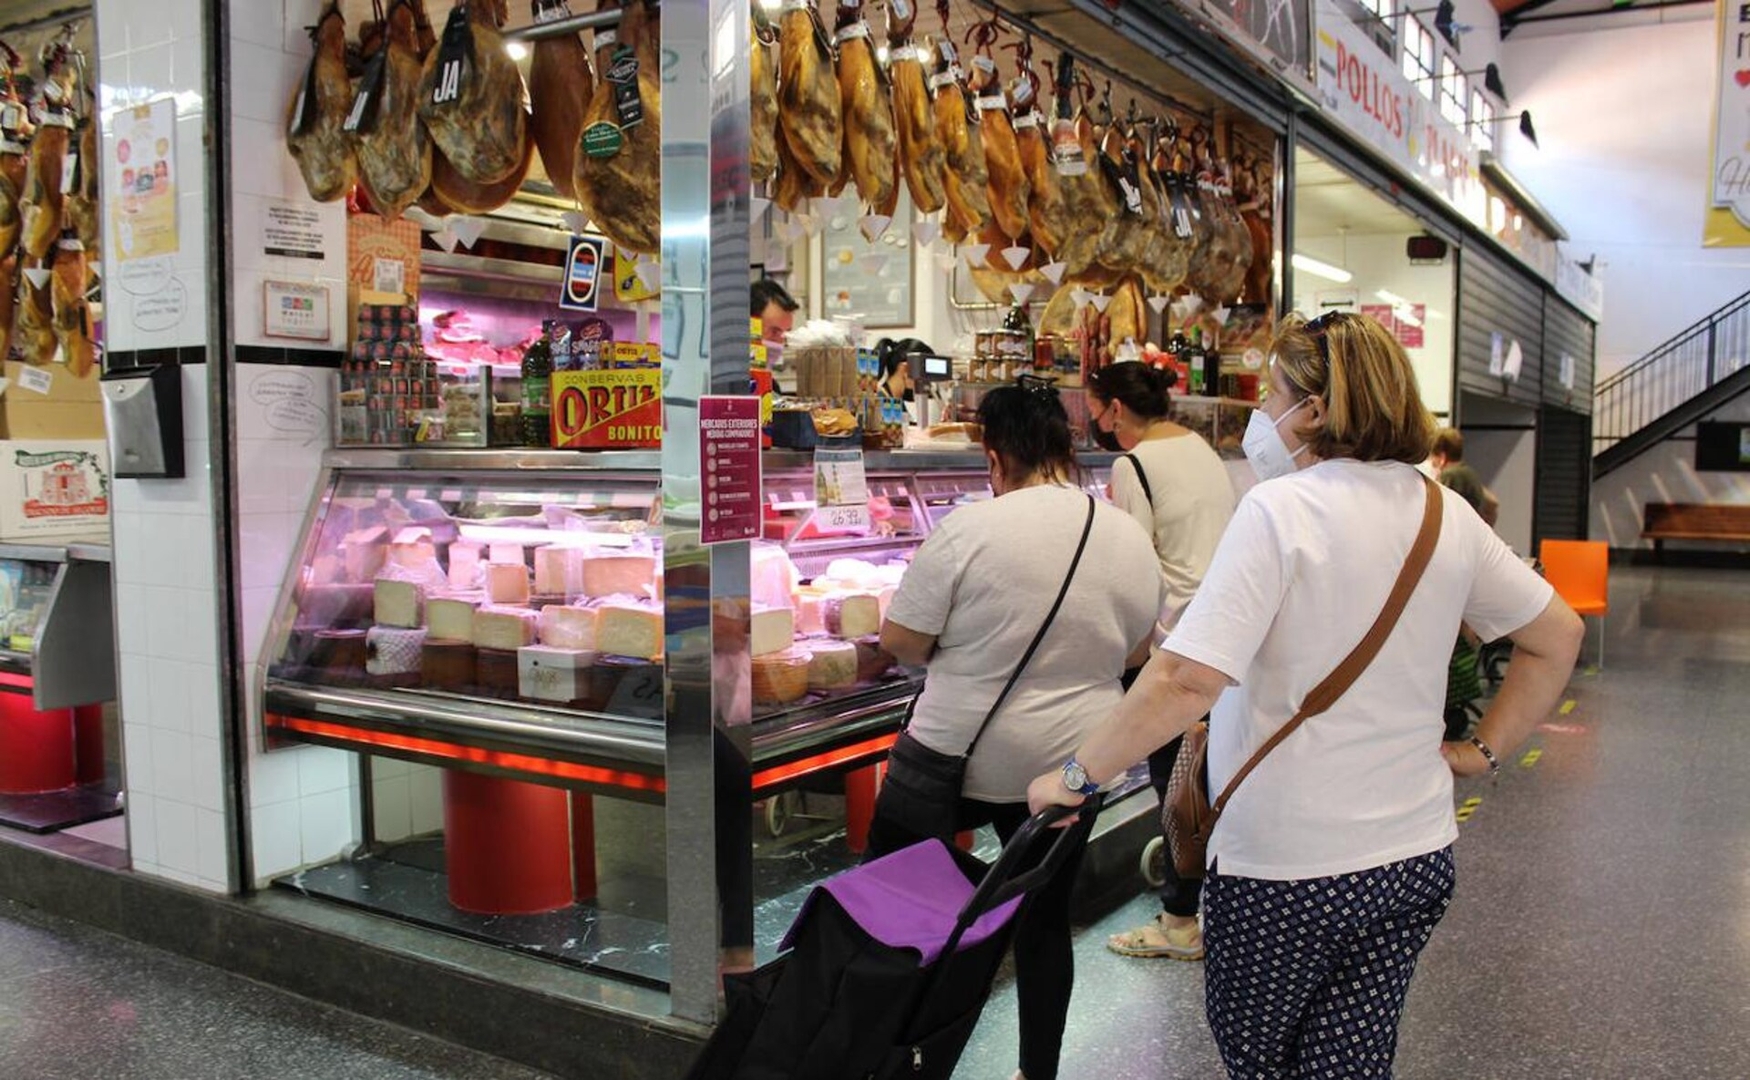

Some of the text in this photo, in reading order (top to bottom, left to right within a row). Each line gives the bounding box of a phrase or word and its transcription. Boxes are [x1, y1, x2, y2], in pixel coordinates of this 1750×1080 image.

[433, 60, 459, 103] JA
[1336, 37, 1403, 140] POLLOS
[565, 374, 646, 385] CONSERVAS
[608, 425, 661, 441] BONITO
